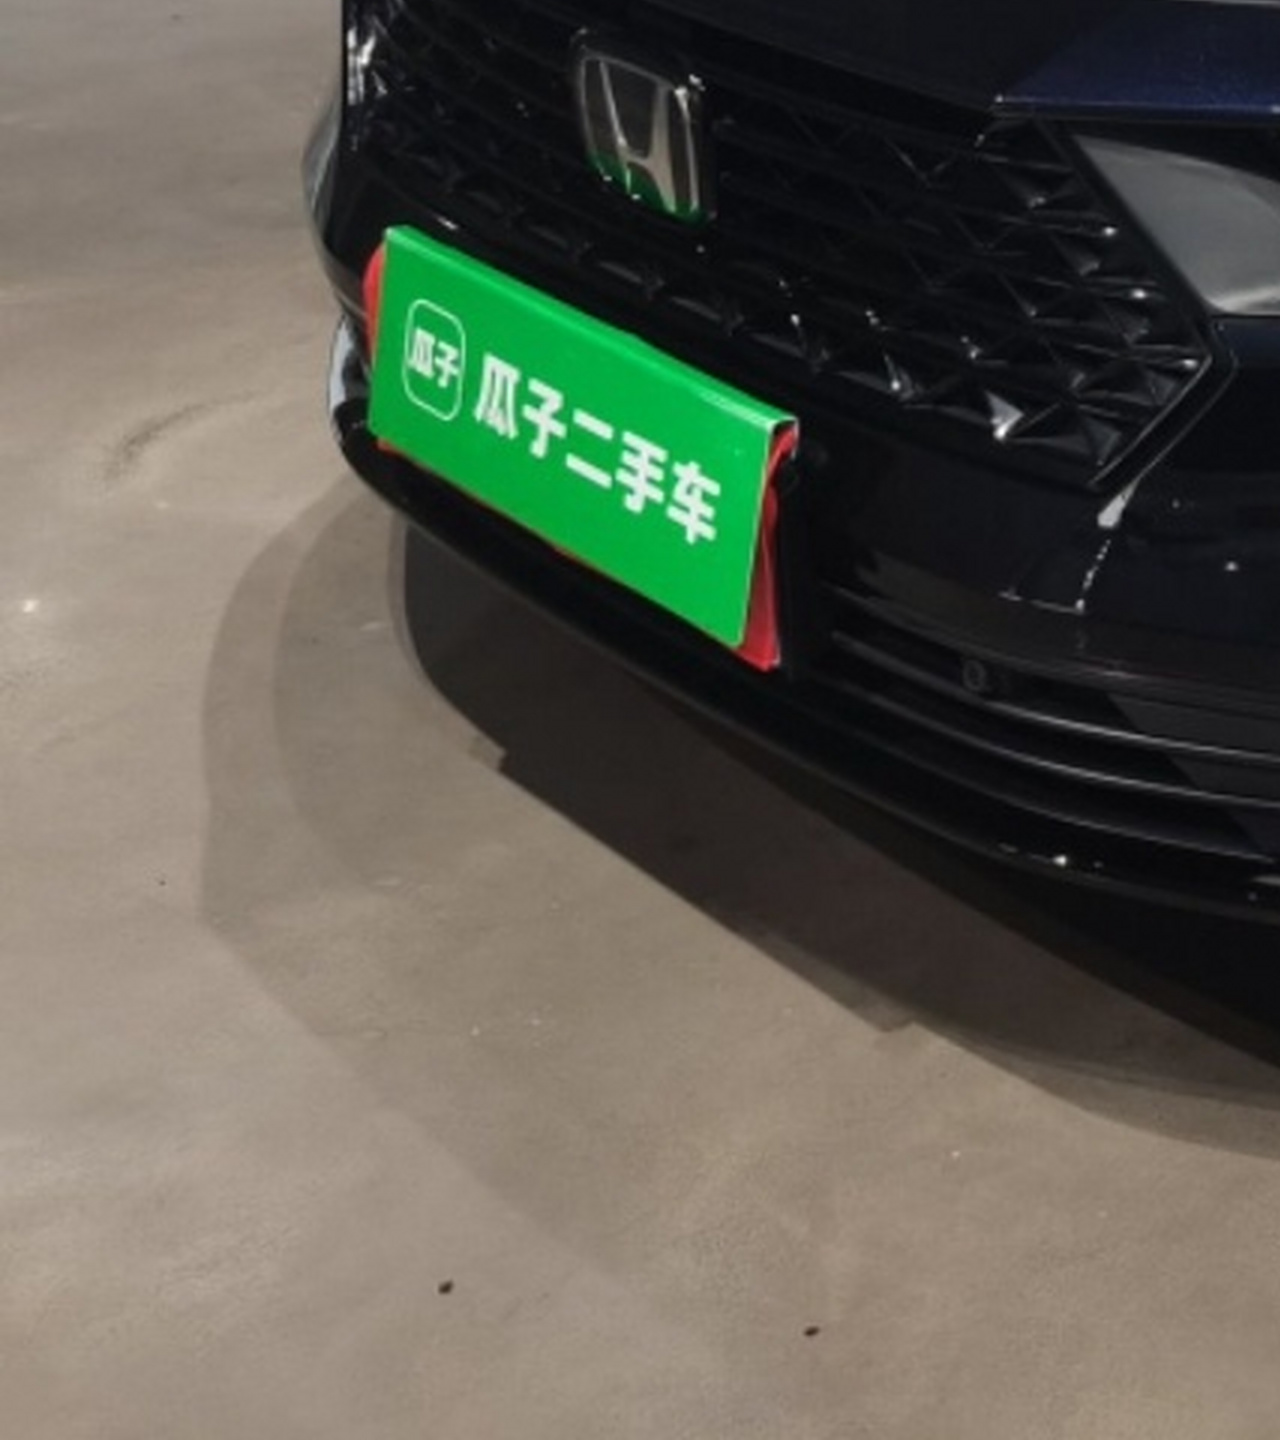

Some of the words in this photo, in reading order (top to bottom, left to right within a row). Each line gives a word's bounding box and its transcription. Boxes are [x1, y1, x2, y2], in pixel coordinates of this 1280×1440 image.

[407, 327, 460, 389] 瓜子
[474, 352, 722, 545] 瓜子二手车
